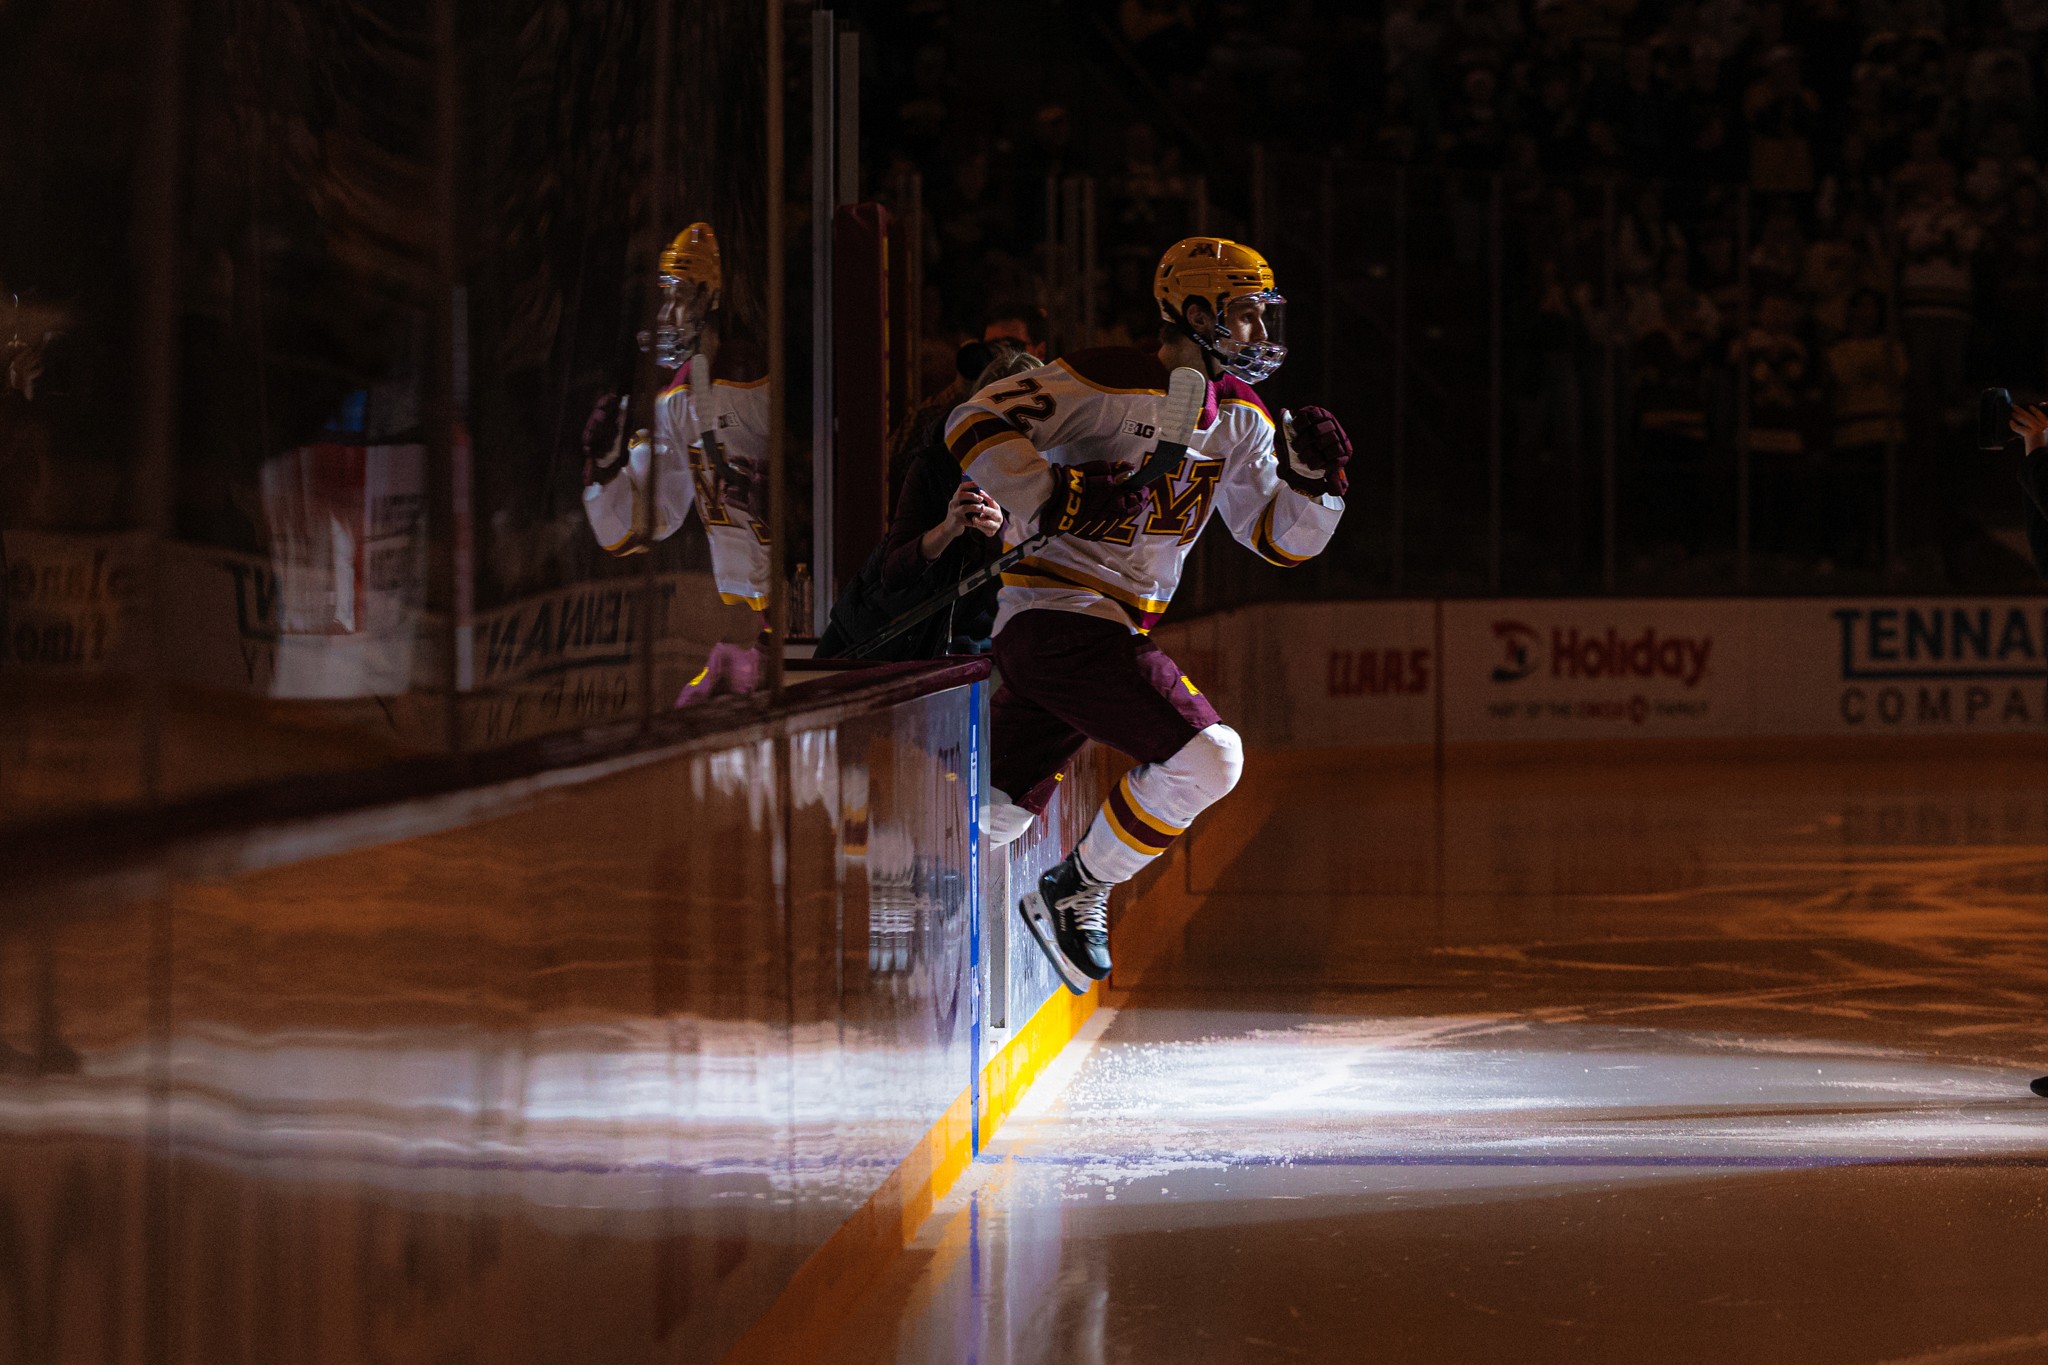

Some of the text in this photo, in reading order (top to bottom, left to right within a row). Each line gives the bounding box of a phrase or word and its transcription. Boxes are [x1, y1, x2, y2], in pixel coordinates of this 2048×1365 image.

[988, 377, 1057, 434] 72
[1057, 467, 1085, 532] CCM
[1551, 627, 1713, 687] Holiday
[1832, 608, 2048, 668] TENNA
[1840, 686, 2048, 725] COMPA
